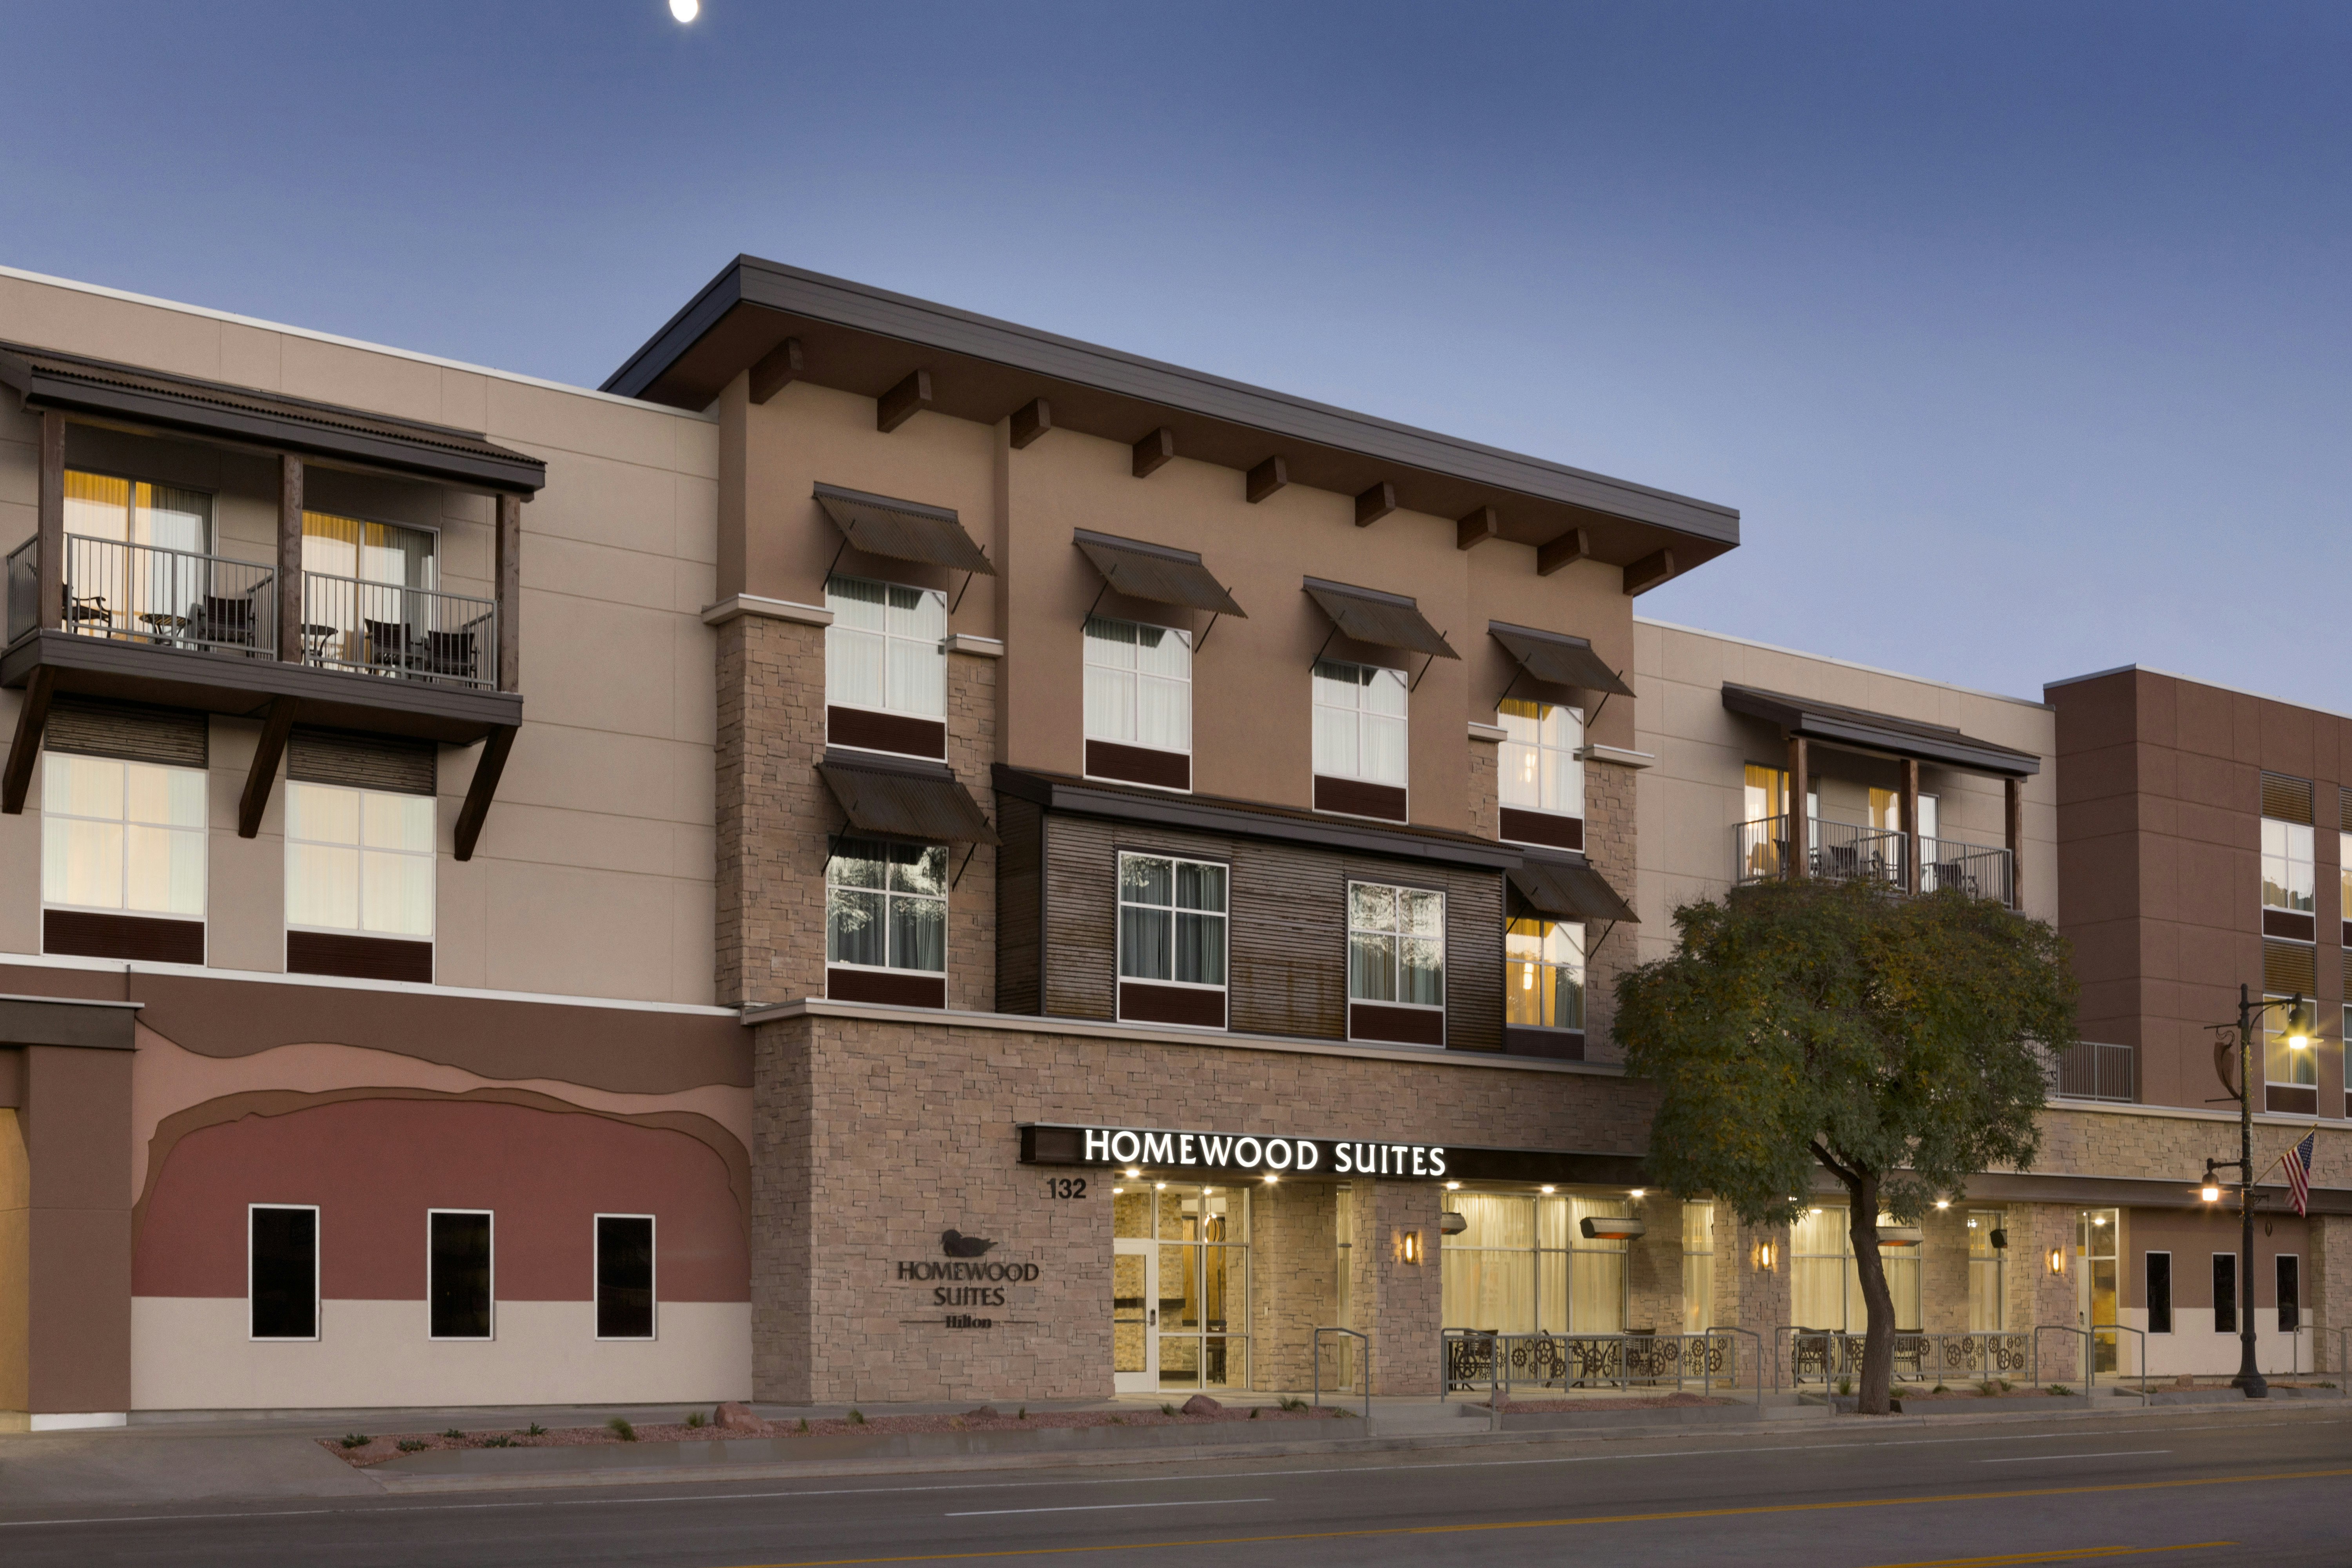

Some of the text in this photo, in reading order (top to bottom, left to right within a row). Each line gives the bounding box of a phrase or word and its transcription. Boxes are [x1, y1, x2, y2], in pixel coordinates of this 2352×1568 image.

[1085, 1130, 1445, 1176] HOMEWOOD SUITES
[1047, 1178, 1086, 1198] 132
[898, 1261, 1039, 1281] HOMEWOOD
[934, 1287, 1005, 1306] SUITES
[946, 1314, 992, 1328] Hilton
